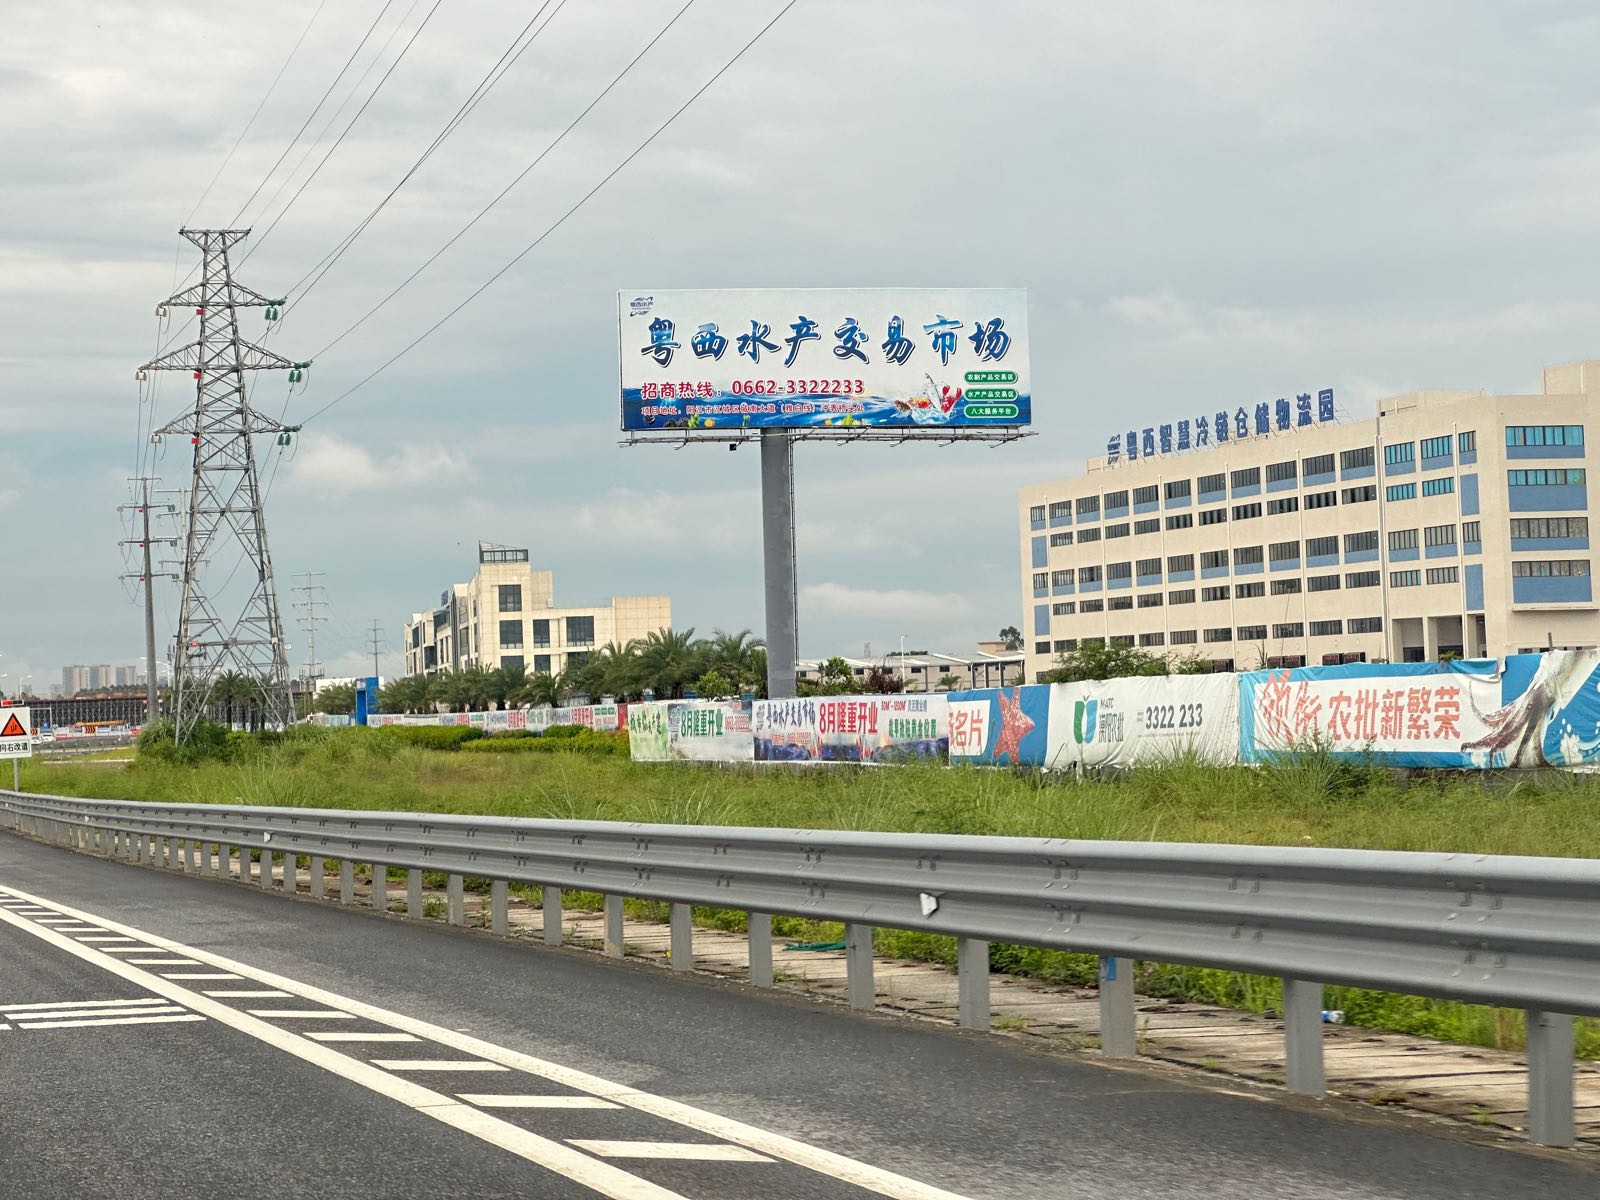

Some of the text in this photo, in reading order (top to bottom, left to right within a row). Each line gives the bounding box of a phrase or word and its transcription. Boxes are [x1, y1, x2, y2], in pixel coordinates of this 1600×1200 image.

[641, 316, 1010, 367] 粤西水产交易市场
[732, 380, 864, 396] 0662-3322233
[1126, 388, 1335, 461] 粤西智慧冷链仓储物流园
[681, 709, 723, 737] 8月隆重开业
[767, 700, 816, 728] 粤西水产交易市场
[819, 701, 879, 734] 8月隆重开业
[1145, 705, 1175, 730] 3322
[1179, 703, 1204, 728] 233
